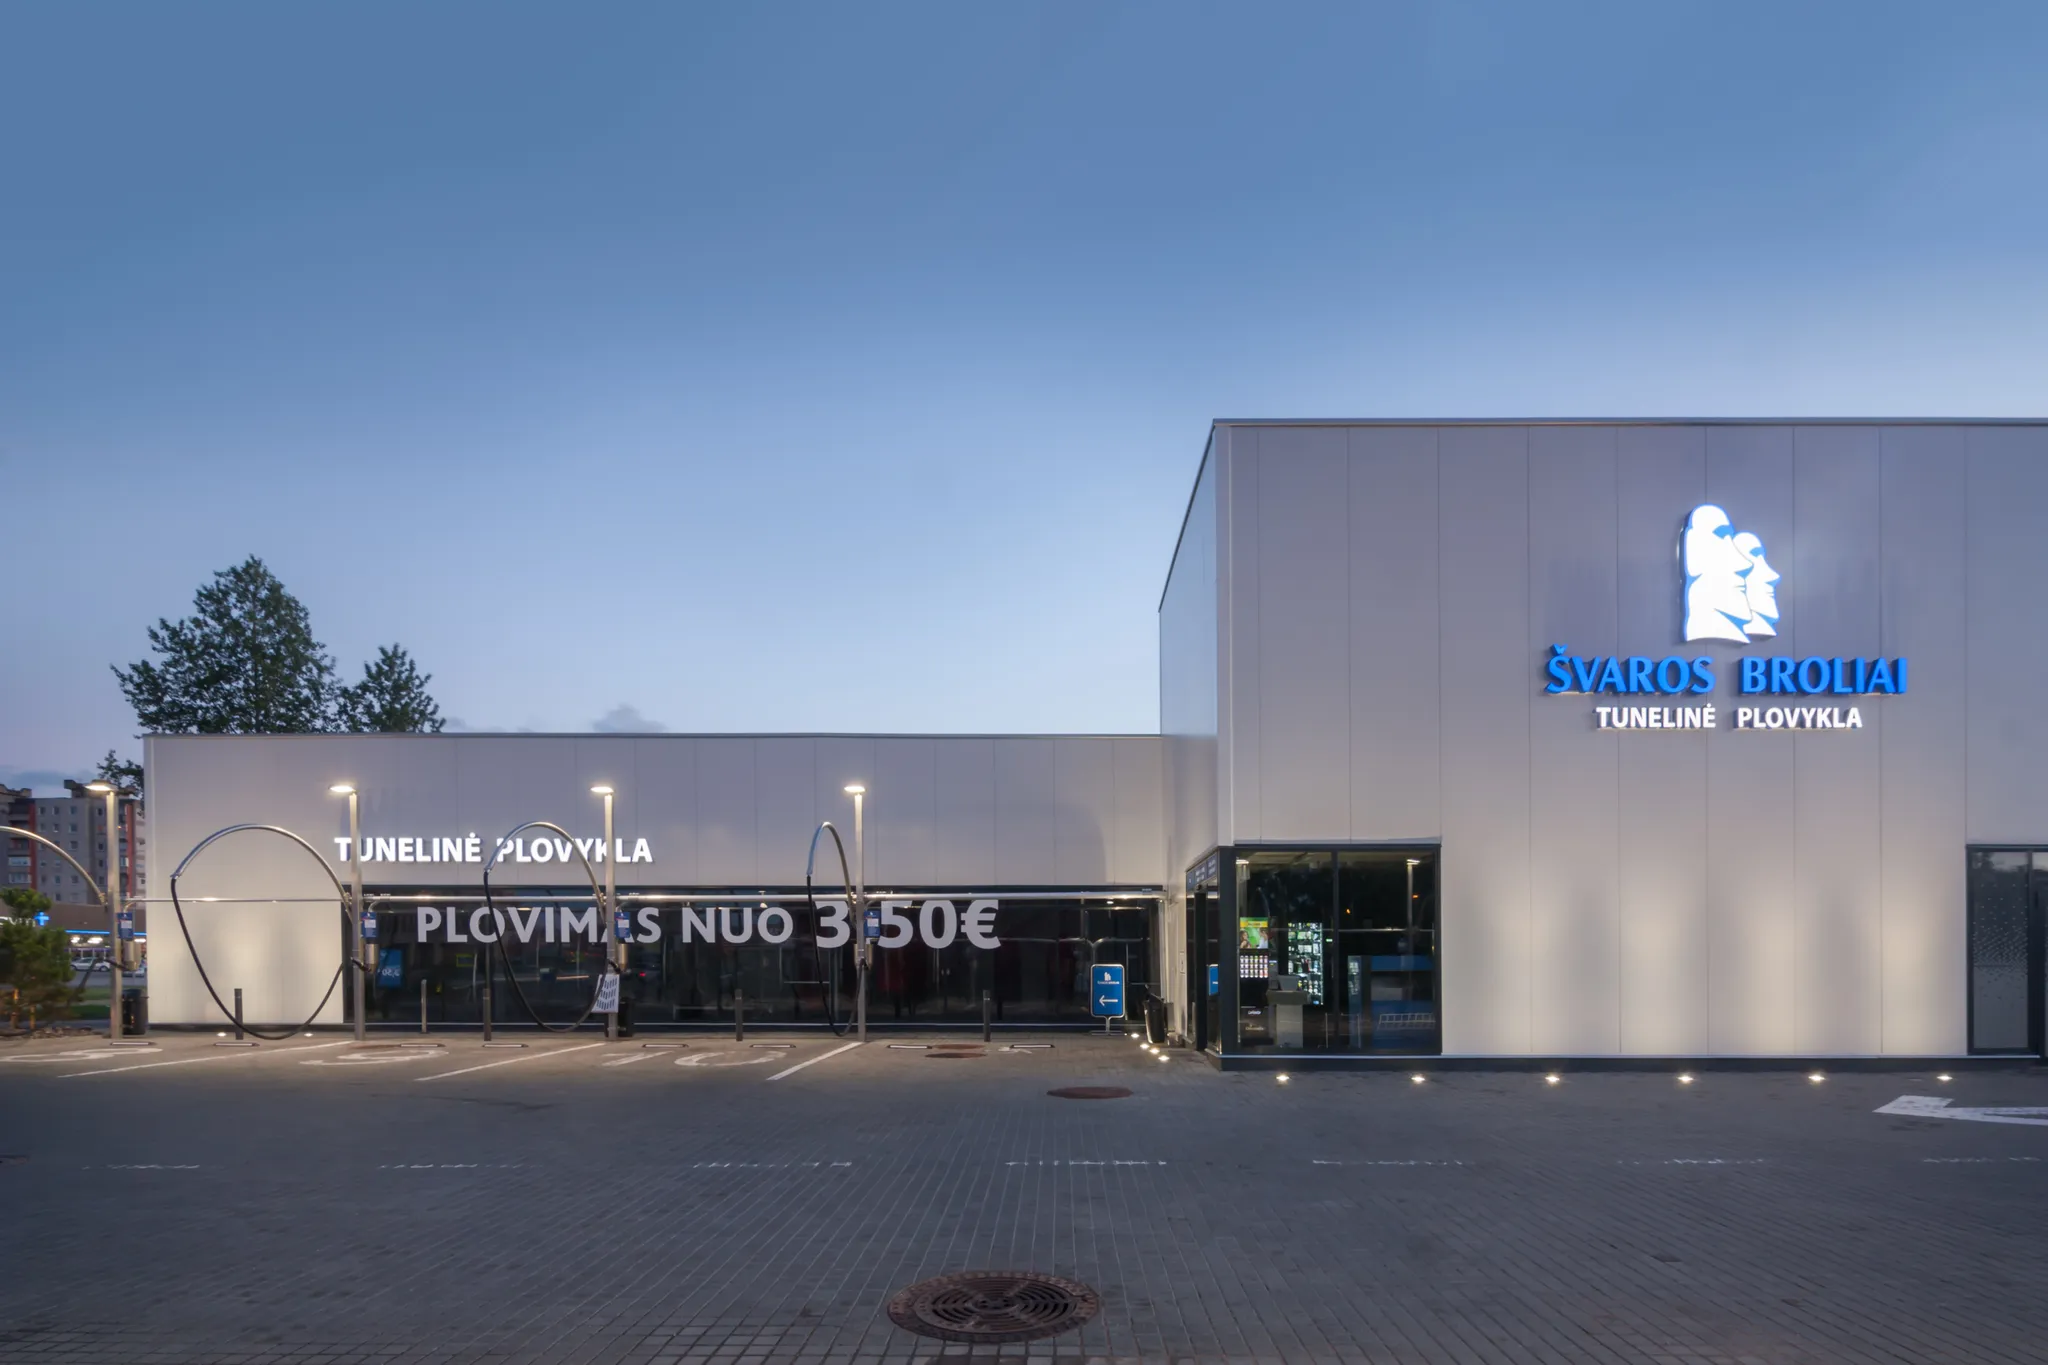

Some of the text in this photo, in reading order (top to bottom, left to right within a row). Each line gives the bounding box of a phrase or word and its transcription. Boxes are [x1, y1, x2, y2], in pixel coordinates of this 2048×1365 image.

[1546, 644, 1908, 694] ŠVAROS BROLIAI
[1596, 703, 1863, 728] TUNELINĖ PLOVYKLA
[334, 832, 653, 863] TUNELINĖ PLOVYKLA
[682, 906, 794, 944] NUO
[814, 900, 1001, 949] 350€
